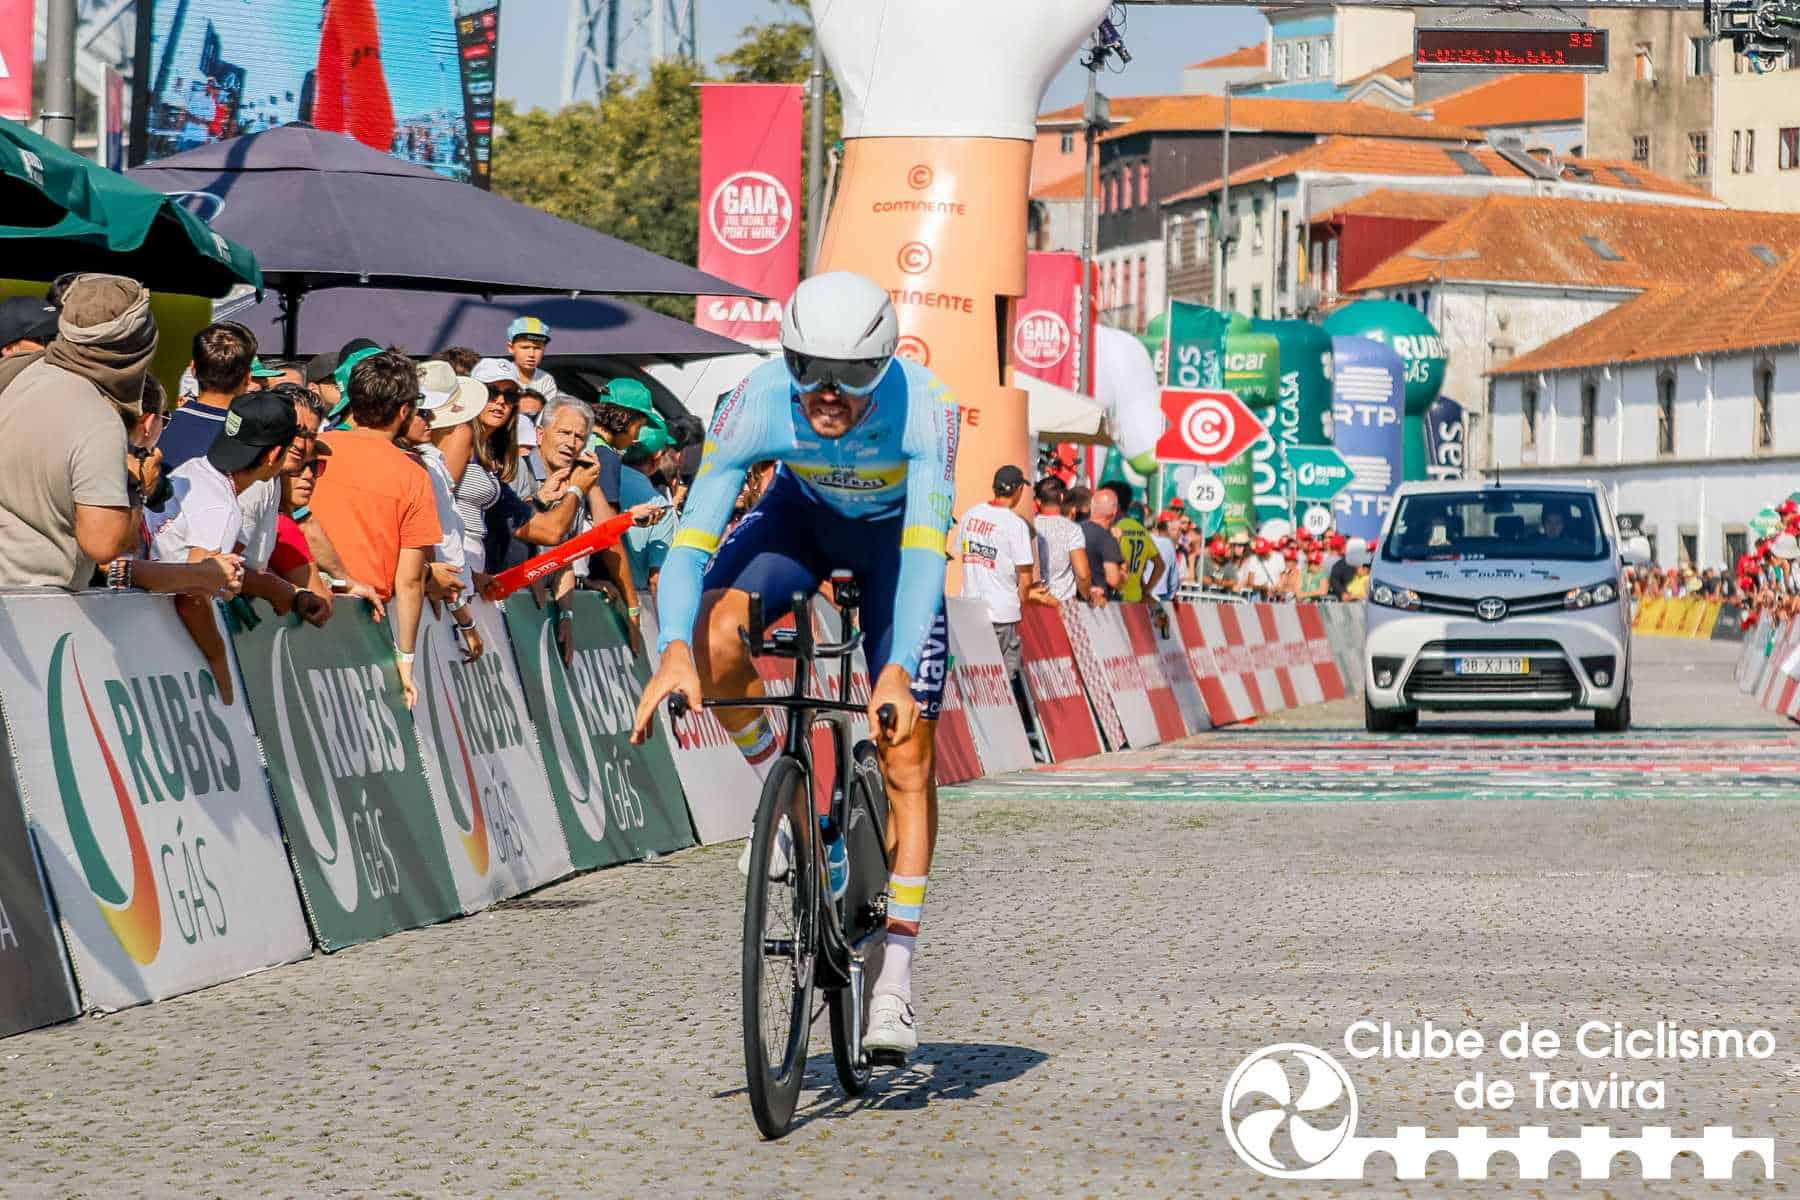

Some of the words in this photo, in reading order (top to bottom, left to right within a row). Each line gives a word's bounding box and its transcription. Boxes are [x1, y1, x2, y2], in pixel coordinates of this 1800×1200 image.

[723, 184, 779, 214] GAIA
[708, 300, 784, 321] GAIA
[1023, 319, 1060, 340] GAIA
[1196, 486, 1215, 500] 25
[966, 517, 997, 536] STAFF
[604, 745, 645, 832] GÁS
[484, 766, 524, 864] GÁS
[352, 788, 400, 900] GÁS
[160, 815, 227, 945] GÁS
